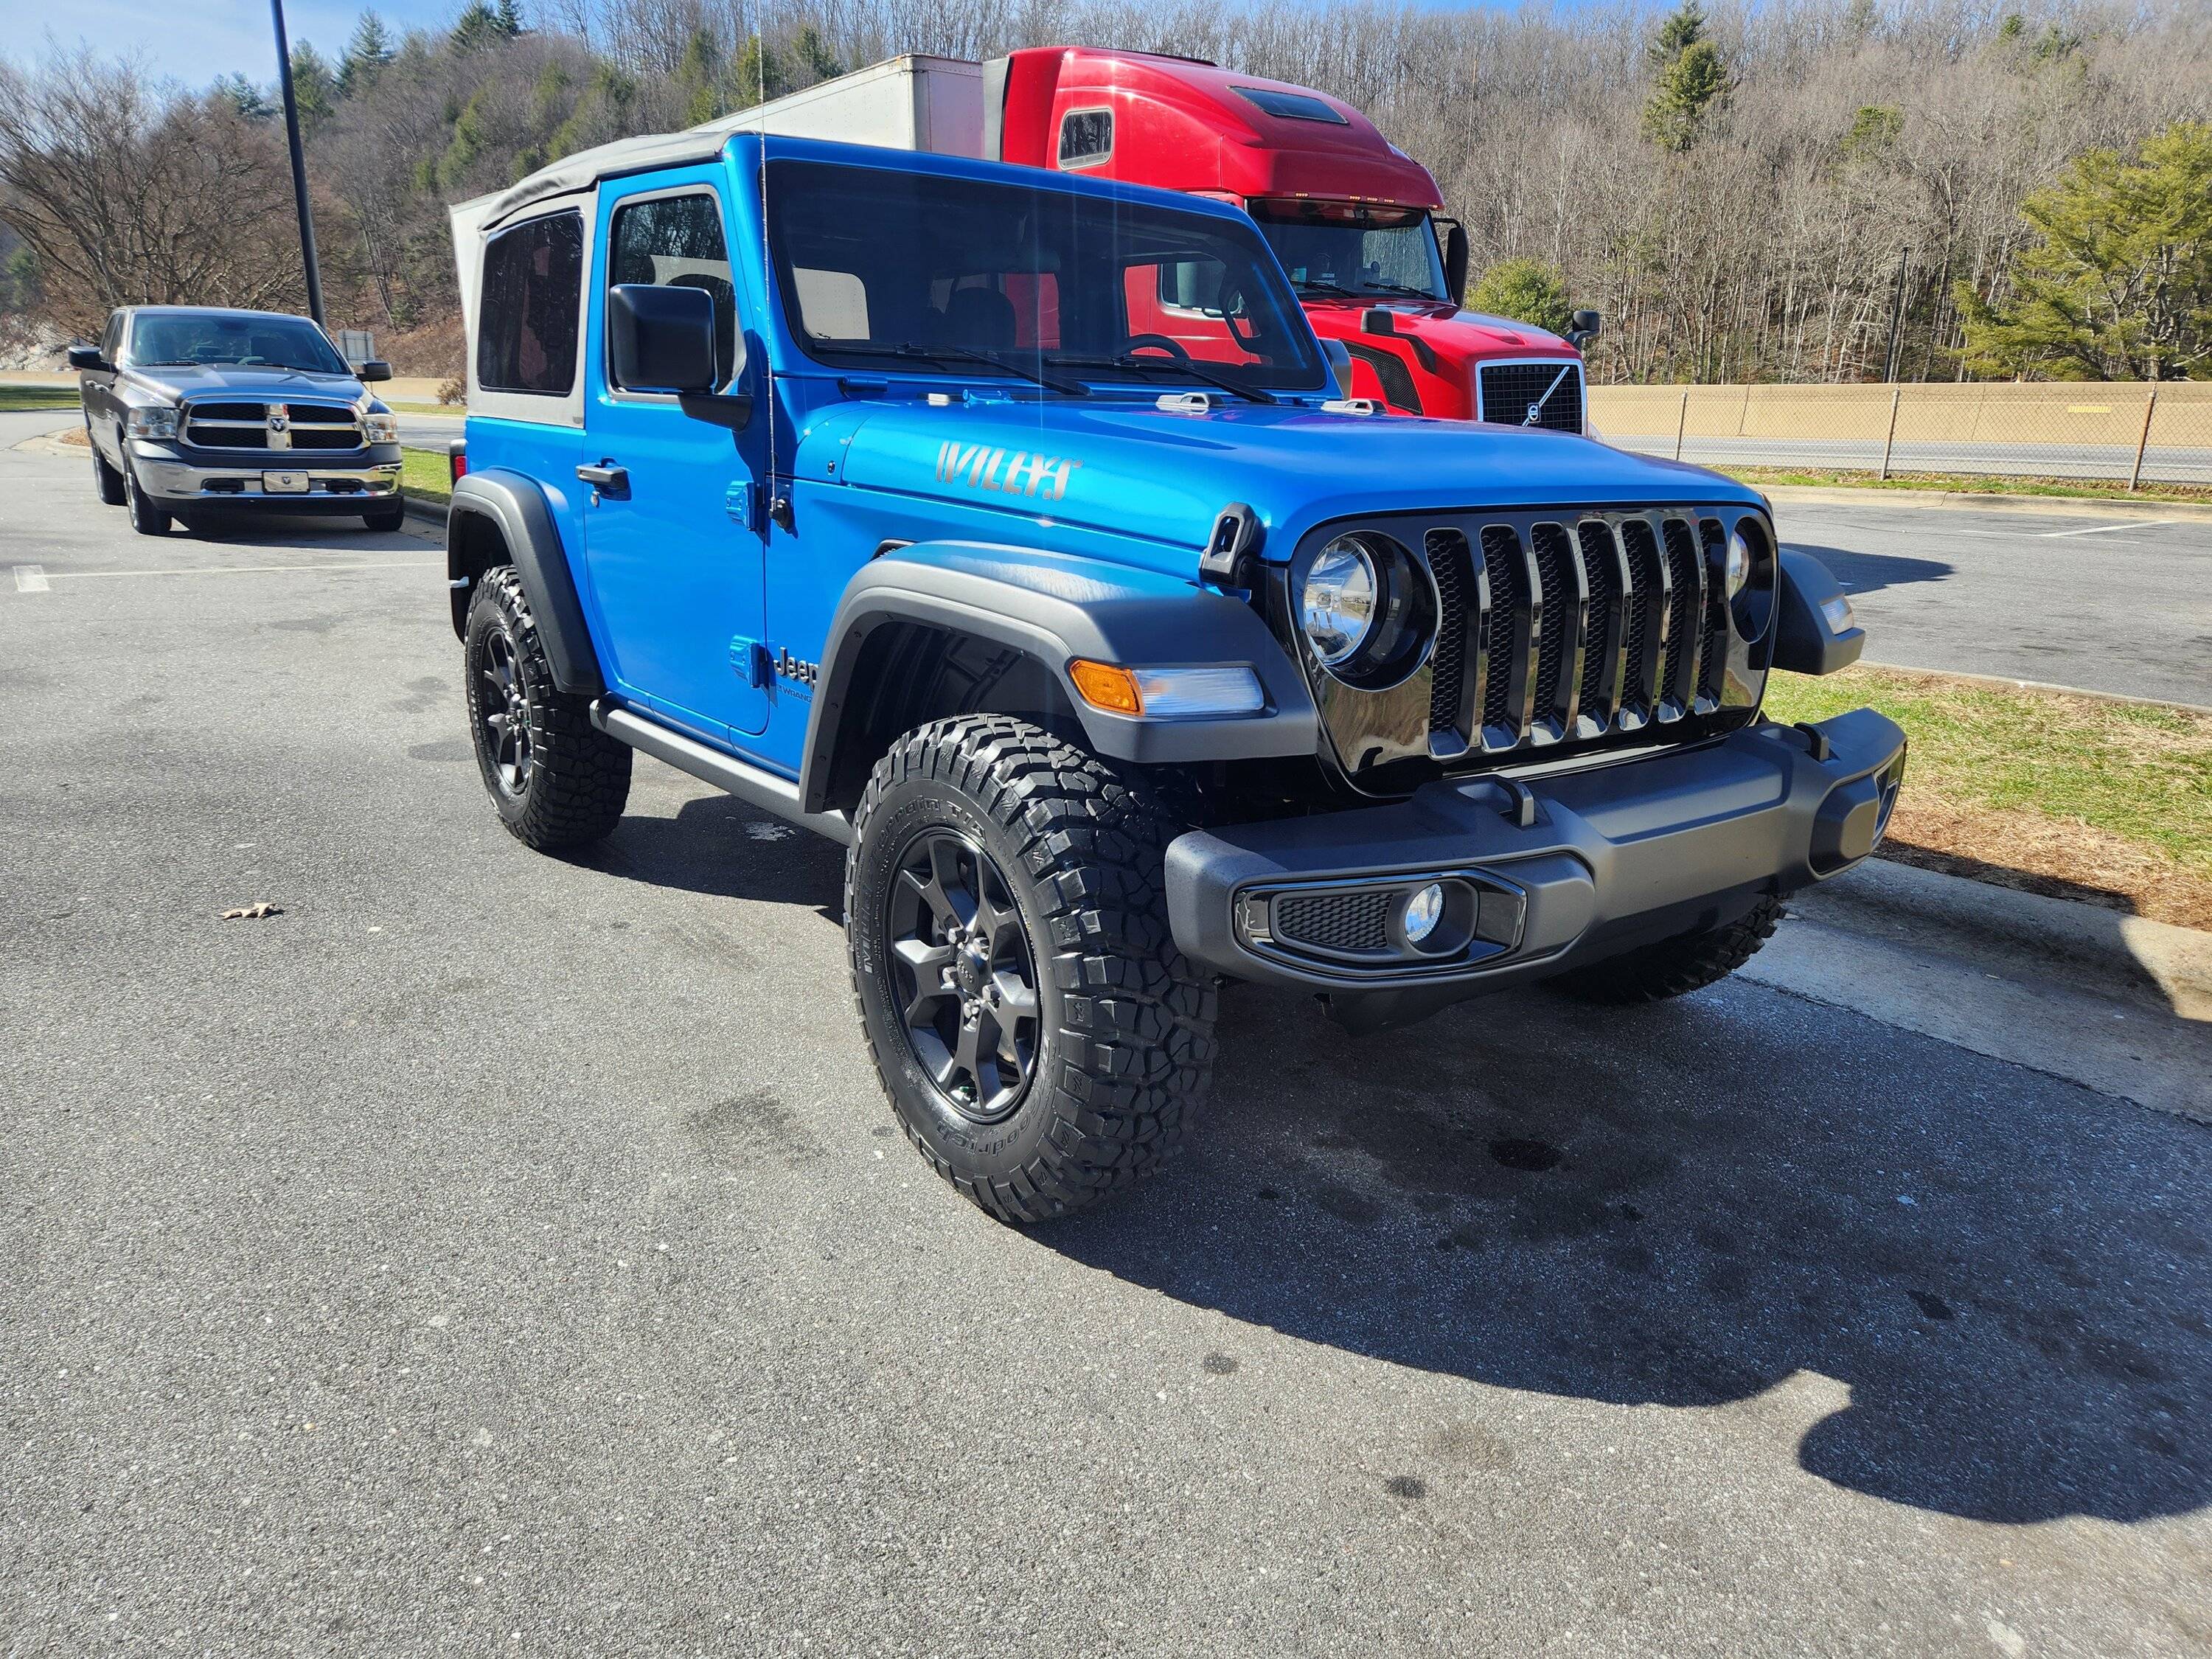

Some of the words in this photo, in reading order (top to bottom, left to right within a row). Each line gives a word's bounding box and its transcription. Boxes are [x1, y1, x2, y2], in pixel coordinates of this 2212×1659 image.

[935, 440, 1085, 501] WILLYS
[773, 646, 820, 694] Jeep
[782, 686, 813, 703] WRANG
